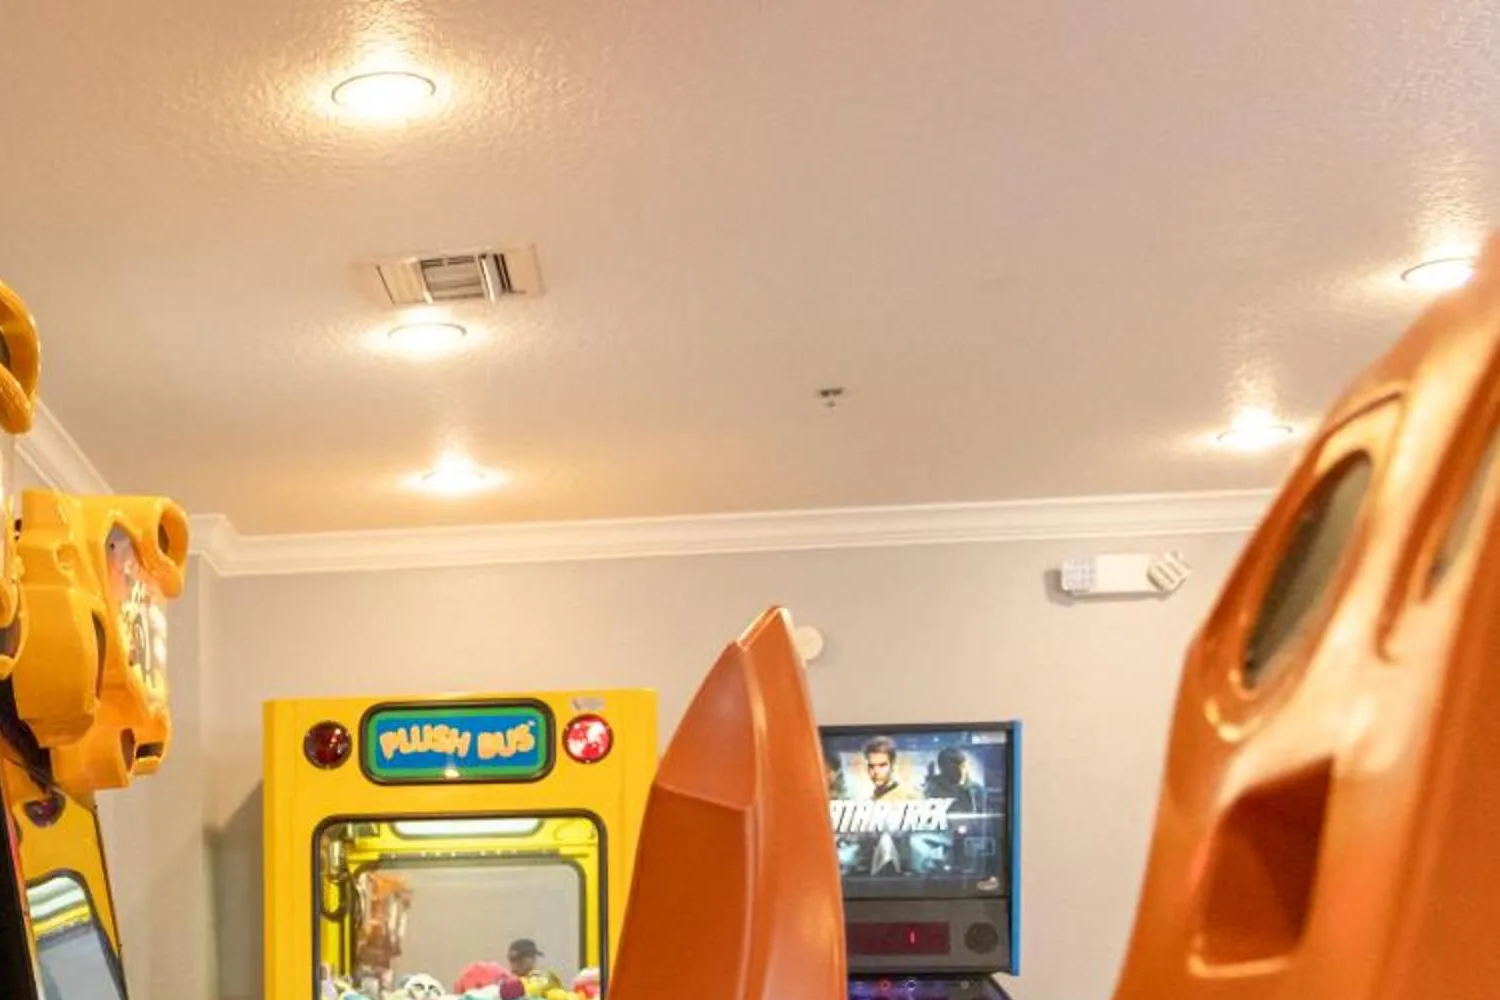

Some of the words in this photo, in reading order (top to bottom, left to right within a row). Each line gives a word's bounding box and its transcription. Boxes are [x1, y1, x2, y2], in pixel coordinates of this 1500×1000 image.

[379, 723, 471, 760] PLUSH
[477, 723, 535, 760] BUS
[895, 797, 957, 833] TREK
